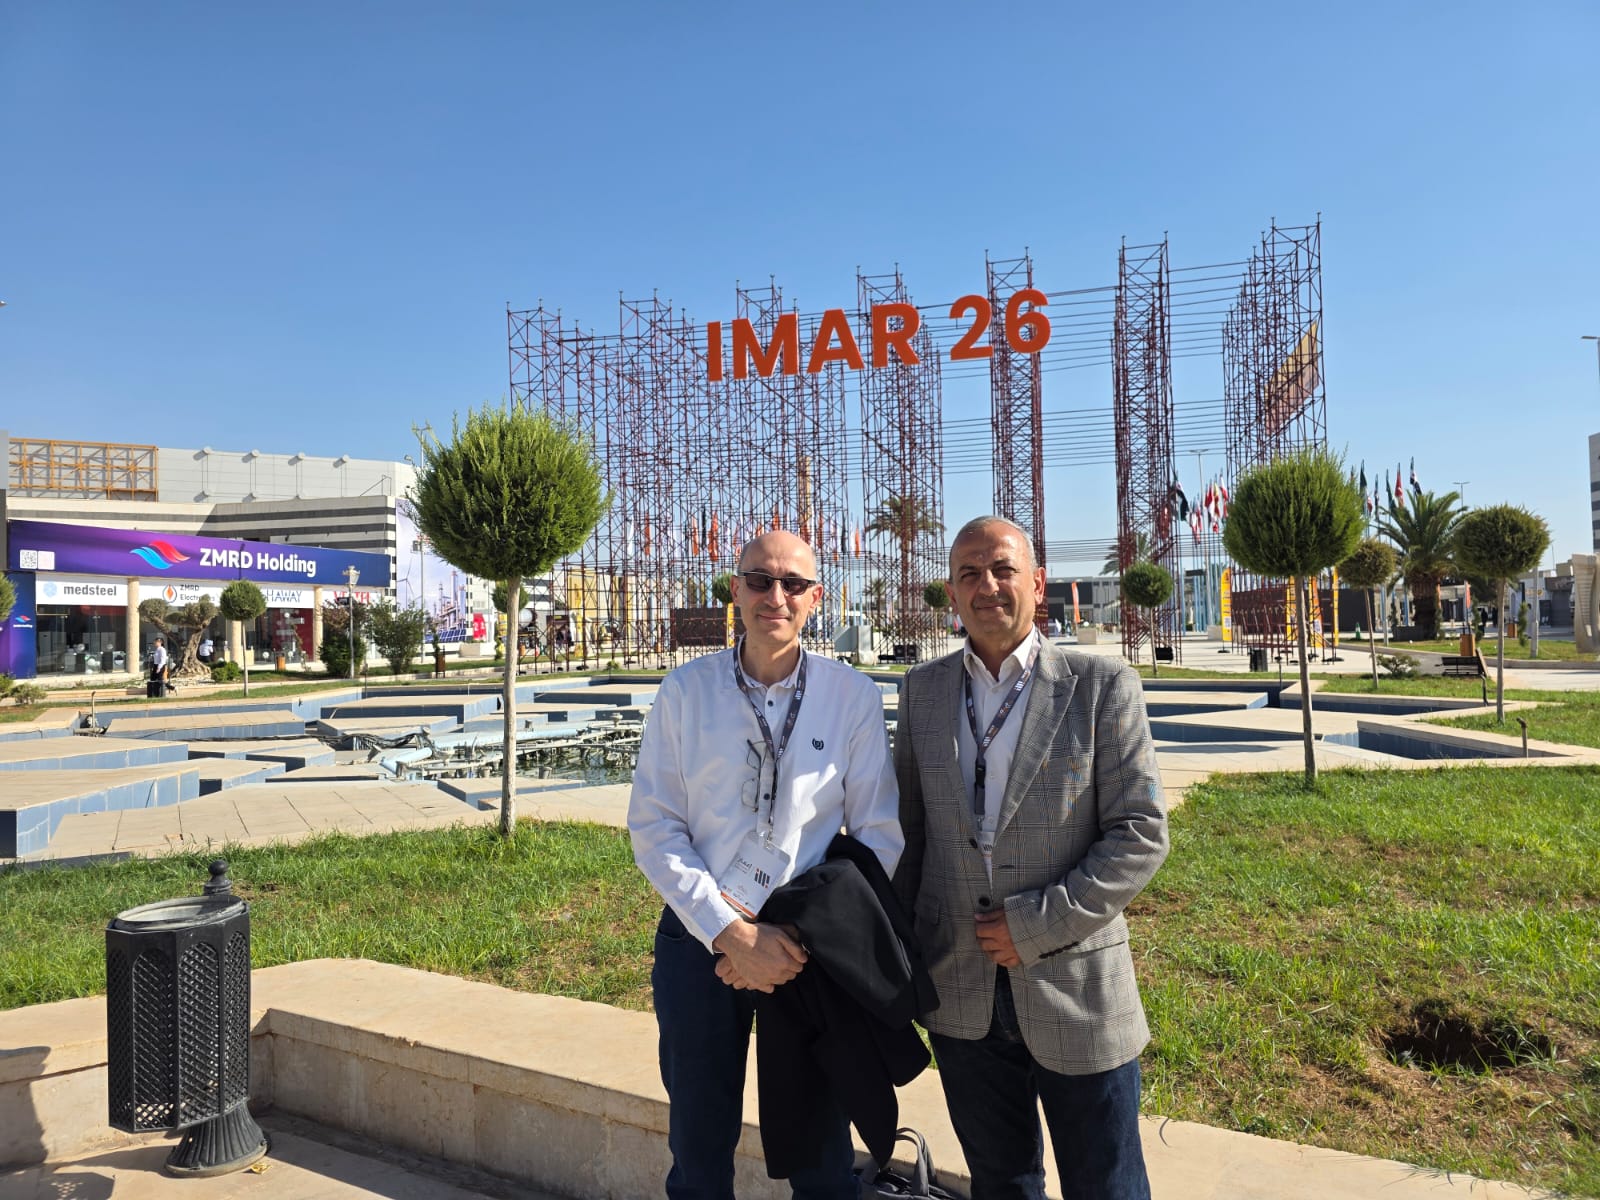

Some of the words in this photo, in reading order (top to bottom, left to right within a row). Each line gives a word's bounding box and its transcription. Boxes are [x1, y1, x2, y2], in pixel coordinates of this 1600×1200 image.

[706, 302, 921, 382] IMAR
[949, 288, 1052, 361] 26
[199, 547, 253, 569] ZMRD
[257, 552, 316, 578] Holding
[63, 584, 117, 597] medsteel
[180, 584, 200, 592] ZMRD
